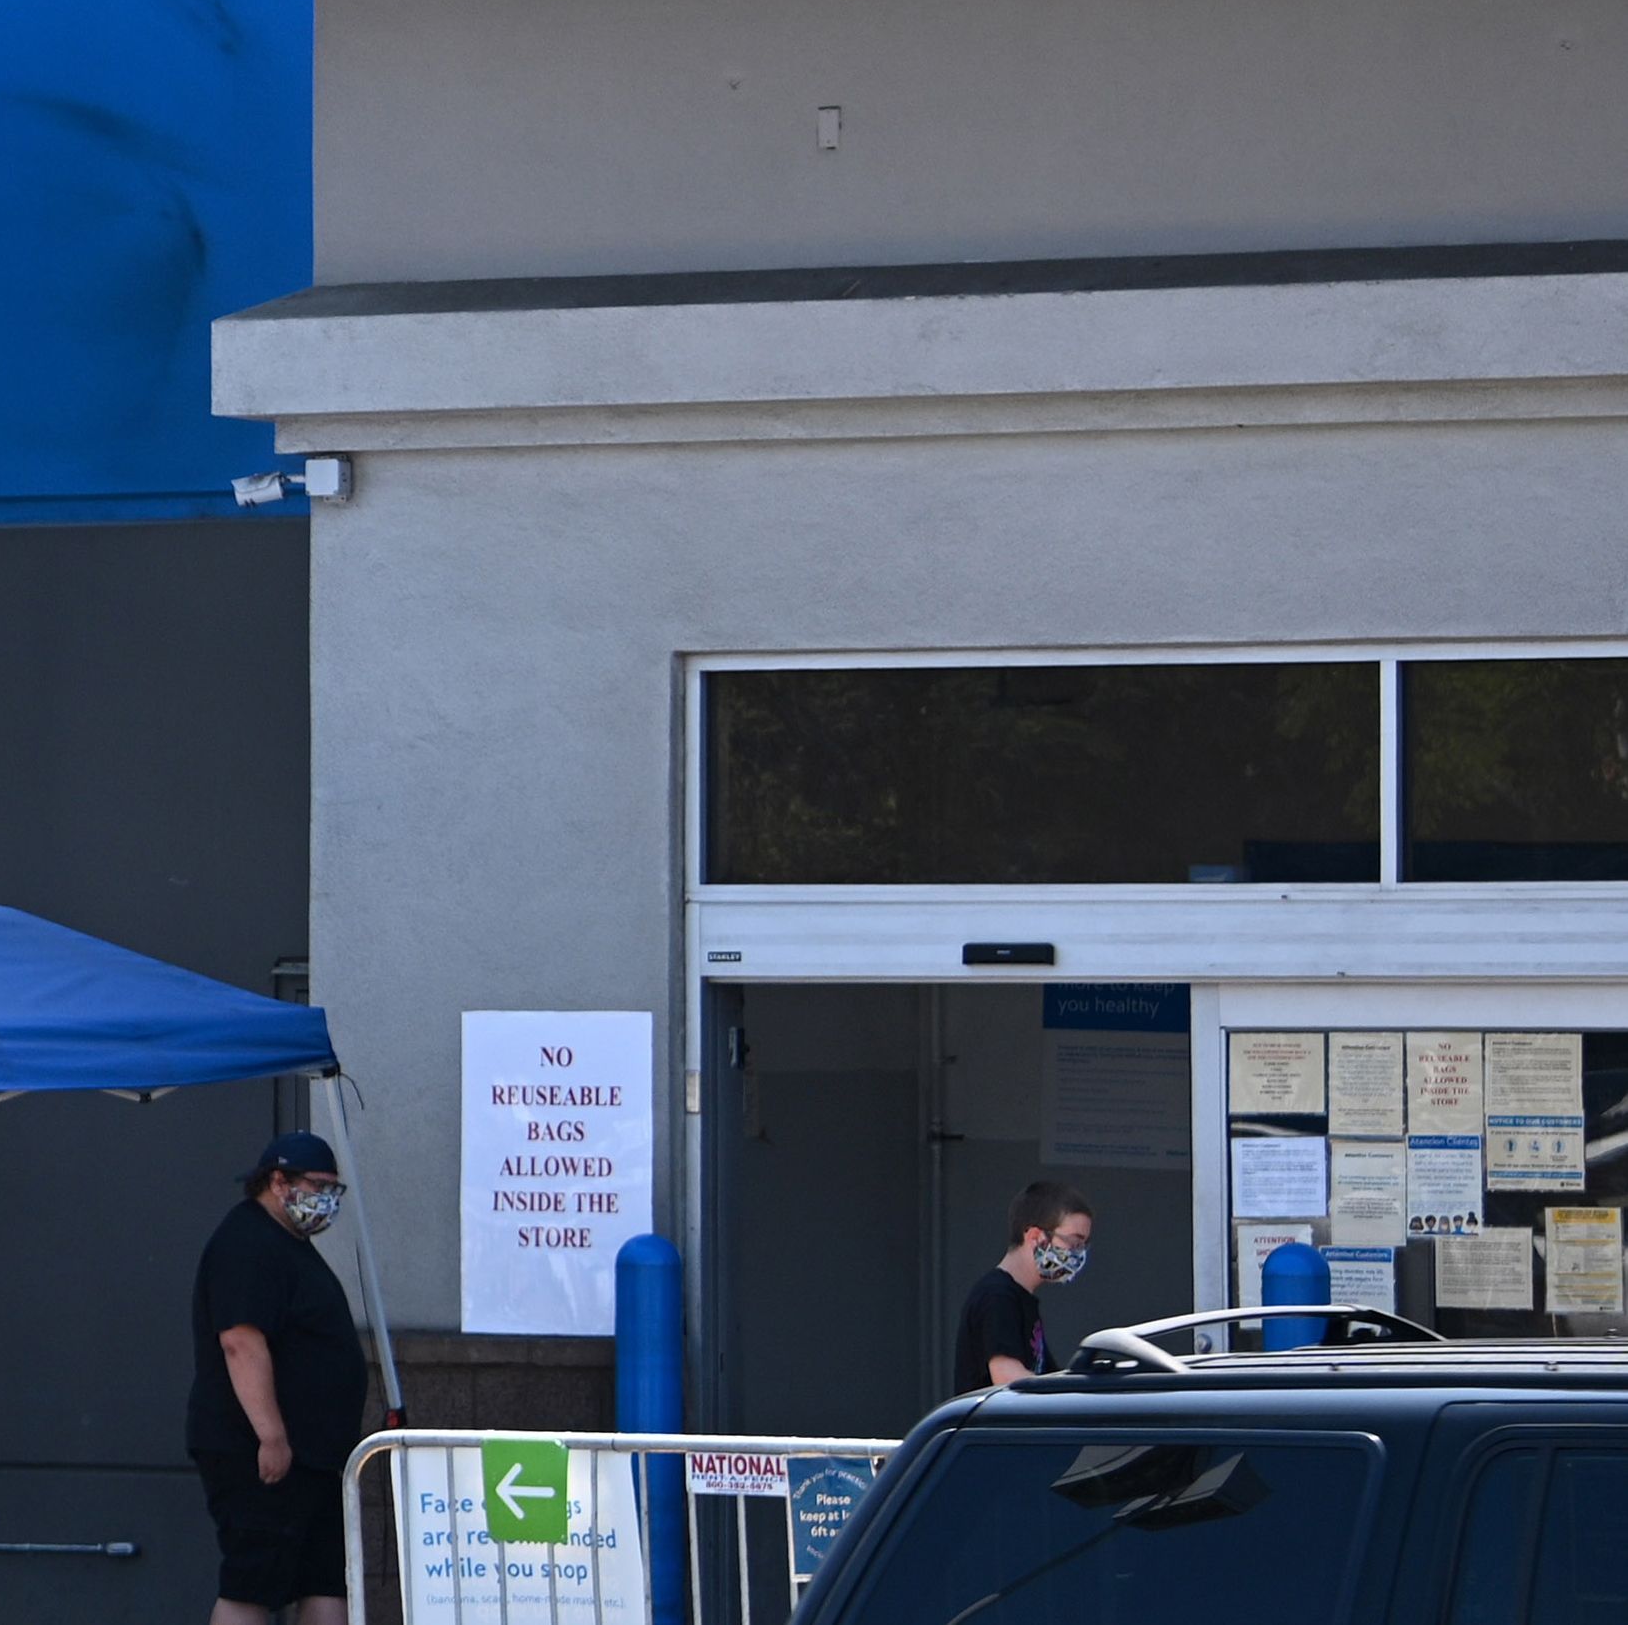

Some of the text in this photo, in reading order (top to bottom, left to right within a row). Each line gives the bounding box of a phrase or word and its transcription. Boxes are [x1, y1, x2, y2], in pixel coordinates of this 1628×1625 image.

[1058, 996, 1160, 1019] you healthy
[540, 1046, 573, 1068] NO
[491, 1085, 622, 1107] REUSEABLE
[527, 1120, 585, 1142] BAGS
[499, 1155, 612, 1177] ALLOWED
[493, 1190, 619, 1214] INSIDE THE
[517, 1226, 592, 1248] STORE
[692, 1454, 786, 1476] NATIONAL
[816, 1493, 851, 1506] Please
[799, 1511, 826, 1524] keep
[828, 1512, 840, 1521] at
[811, 1526, 829, 1538] 6ft
